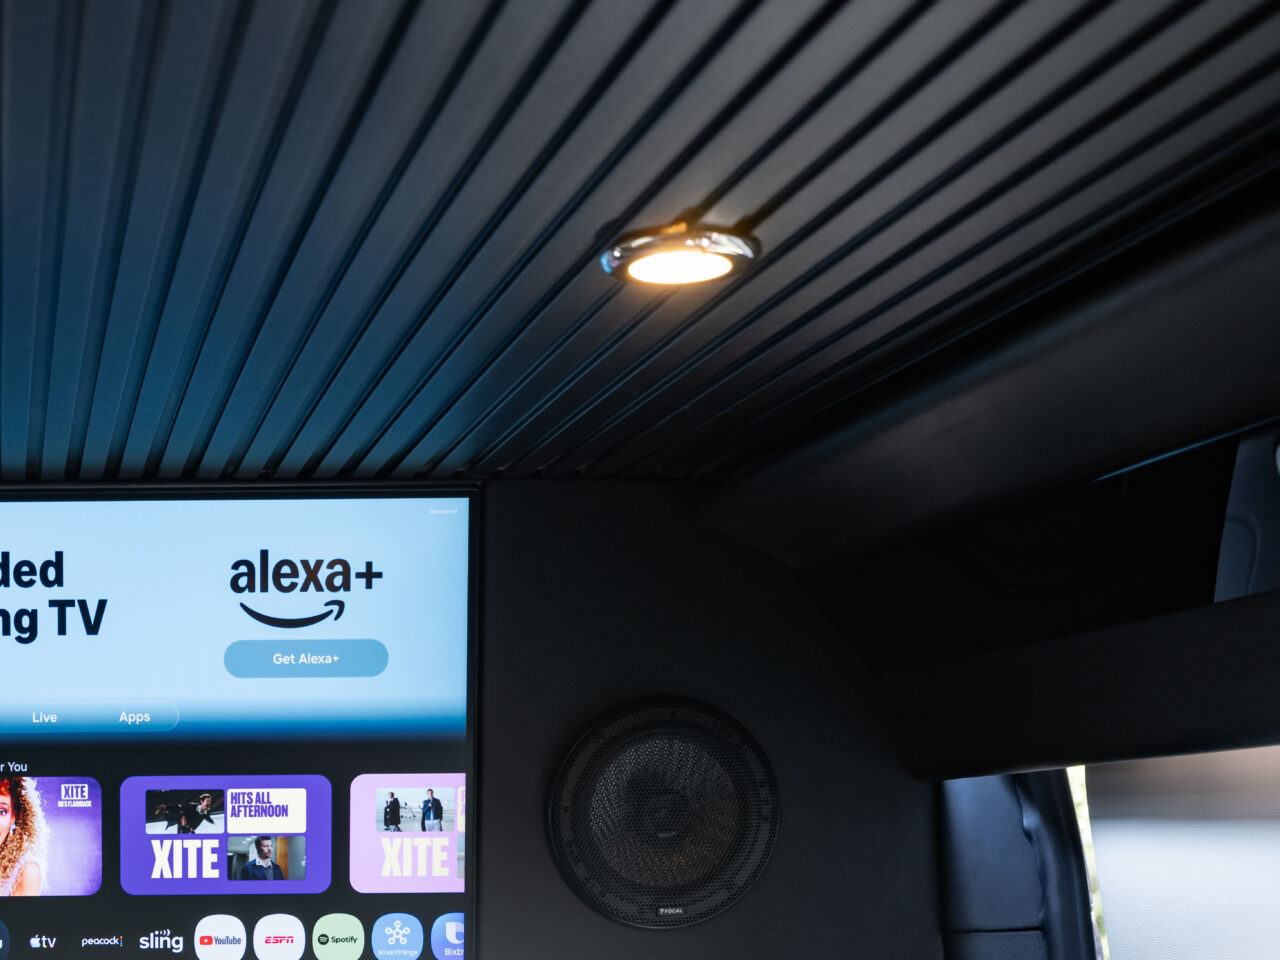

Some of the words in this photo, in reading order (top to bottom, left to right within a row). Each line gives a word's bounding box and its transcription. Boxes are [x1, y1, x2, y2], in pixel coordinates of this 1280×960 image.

[230, 549, 383, 593] alexa+
[49, 599, 107, 636] TV
[273, 653, 295, 664] Get
[298, 653, 339, 664] Alexa+
[32, 712, 57, 723] Live
[119, 711, 151, 725] Apps
[8, 762, 27, 772] You
[63, 785, 86, 799] XITE
[231, 792, 253, 804] HITS
[255, 792, 272, 804] ALL
[231, 804, 288, 818] AFTERNOON
[151, 839, 219, 878] XITE
[381, 837, 449, 877] XITE
[42, 936, 56, 948] tv
[81, 936, 119, 948] peacock
[139, 930, 184, 953] sling
[214, 936, 242, 945] YouTube
[265, 936, 294, 944] ESPN
[331, 936, 358, 944] Spotify
[444, 947, 464, 956] Bixb
